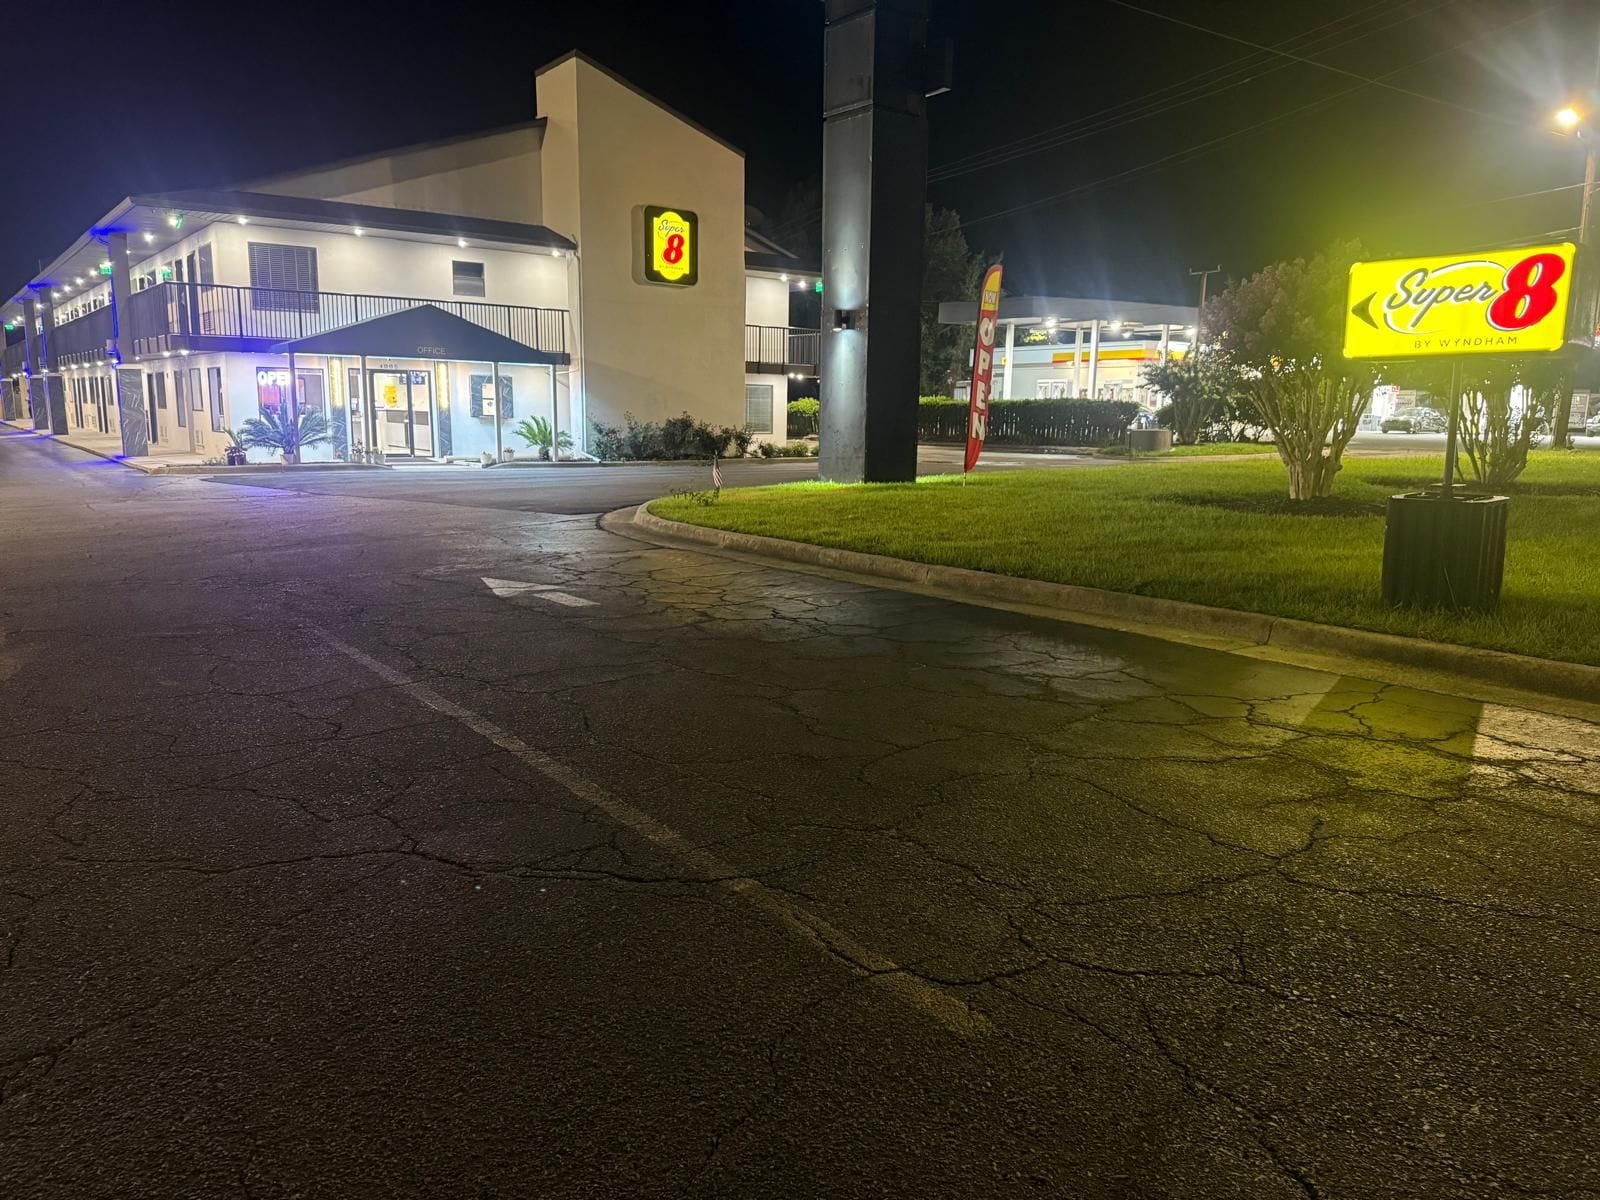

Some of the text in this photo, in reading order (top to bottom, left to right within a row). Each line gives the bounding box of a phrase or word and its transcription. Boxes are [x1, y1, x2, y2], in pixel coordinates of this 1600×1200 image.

[658, 219, 684, 238] Super
[663, 233, 685, 264] 8
[1386, 253, 1566, 331] Super 8
[417, 346, 446, 355] OFFICE
[1414, 336, 1517, 348] BY WYNDHAM
[972, 317, 995, 441] OPEN
